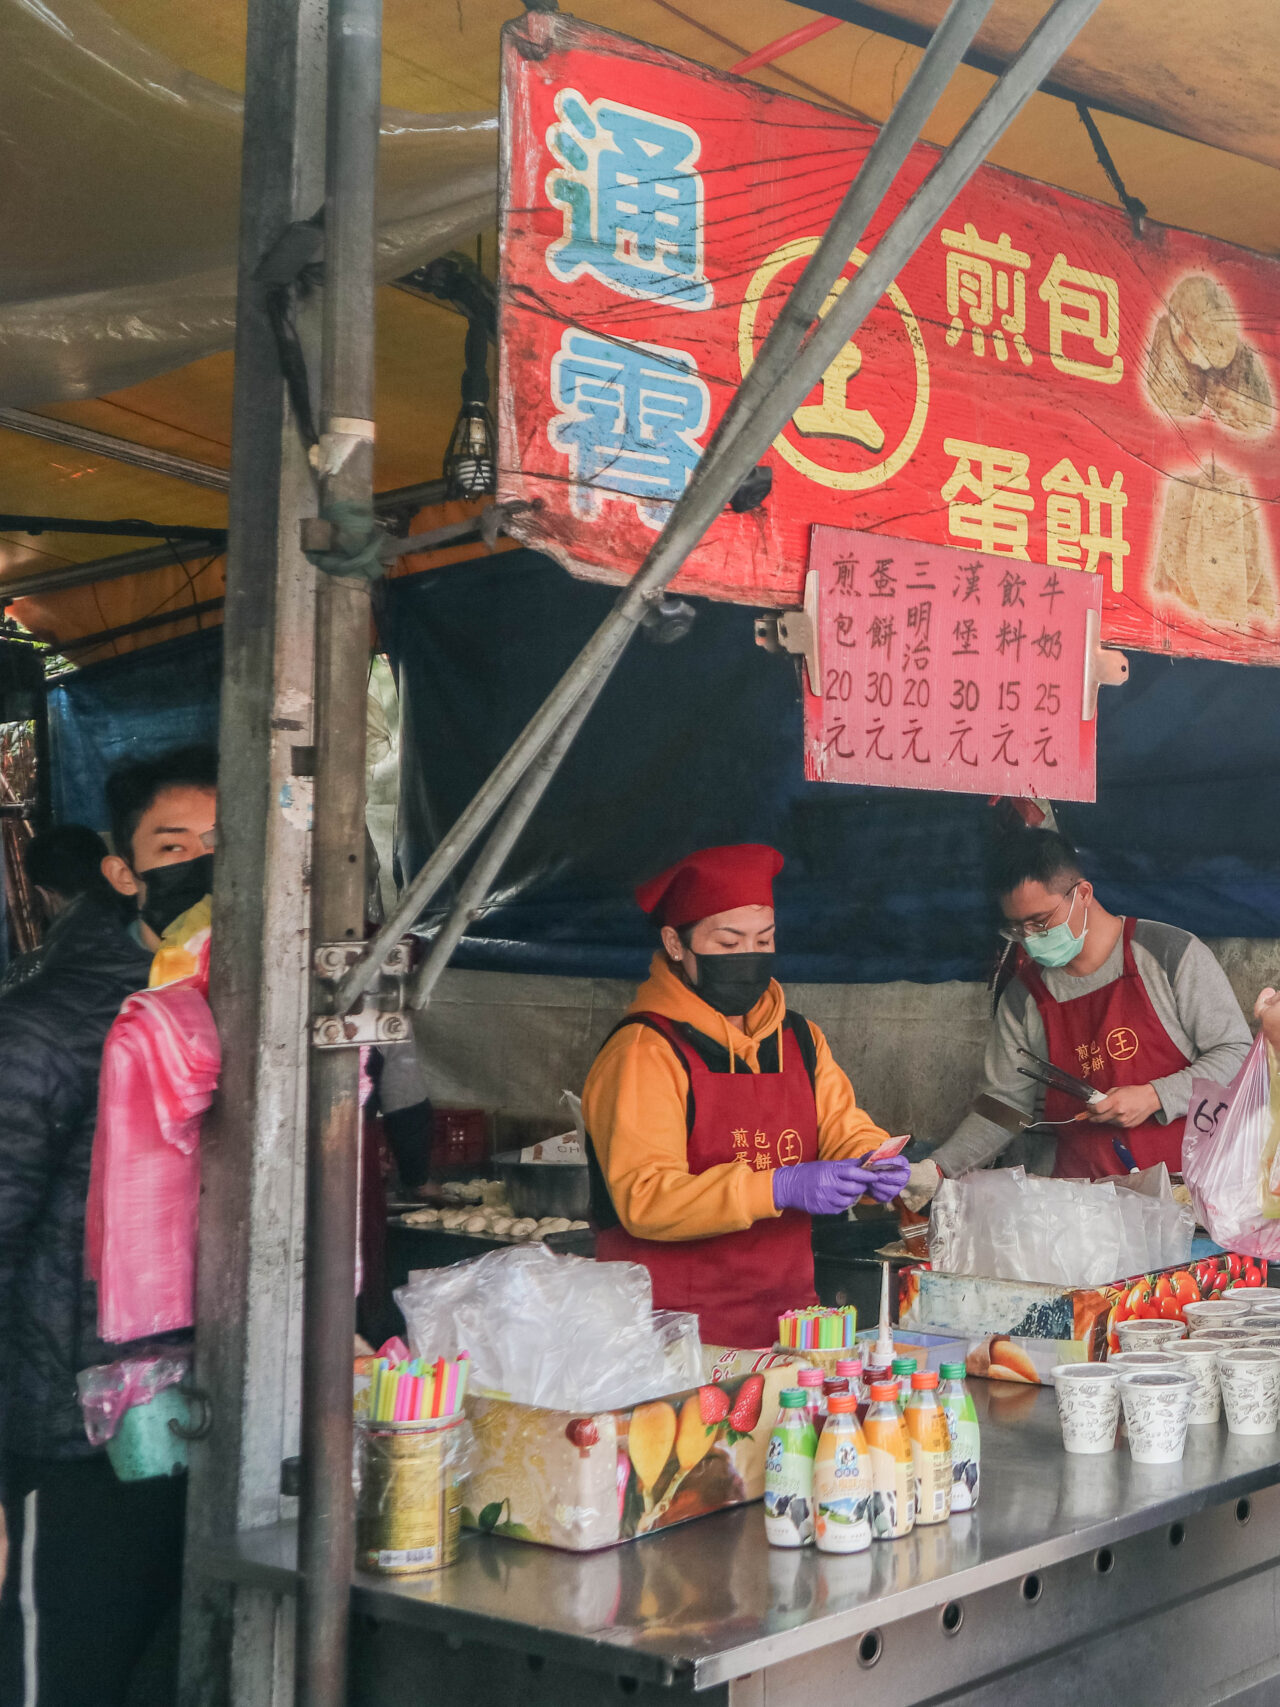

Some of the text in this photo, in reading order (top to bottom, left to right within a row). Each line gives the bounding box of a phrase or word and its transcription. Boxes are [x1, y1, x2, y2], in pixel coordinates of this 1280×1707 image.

[546, 88, 714, 530] 通霄
[940, 222, 1125, 386] 煎包
[940, 437, 1132, 593] 蛋餅
[828, 552, 861, 648] 煎包
[865, 558, 898, 661] 蛋餅
[902, 561, 936, 673] 三明治
[951, 560, 984, 656] 漢堡
[995, 570, 1027, 663] 飲料
[1030, 571, 1064, 661] 牛奶
[1112, 1030, 1135, 1056] 王
[730, 1127, 771, 1149] 煎包
[781, 1133, 800, 1162] 王
